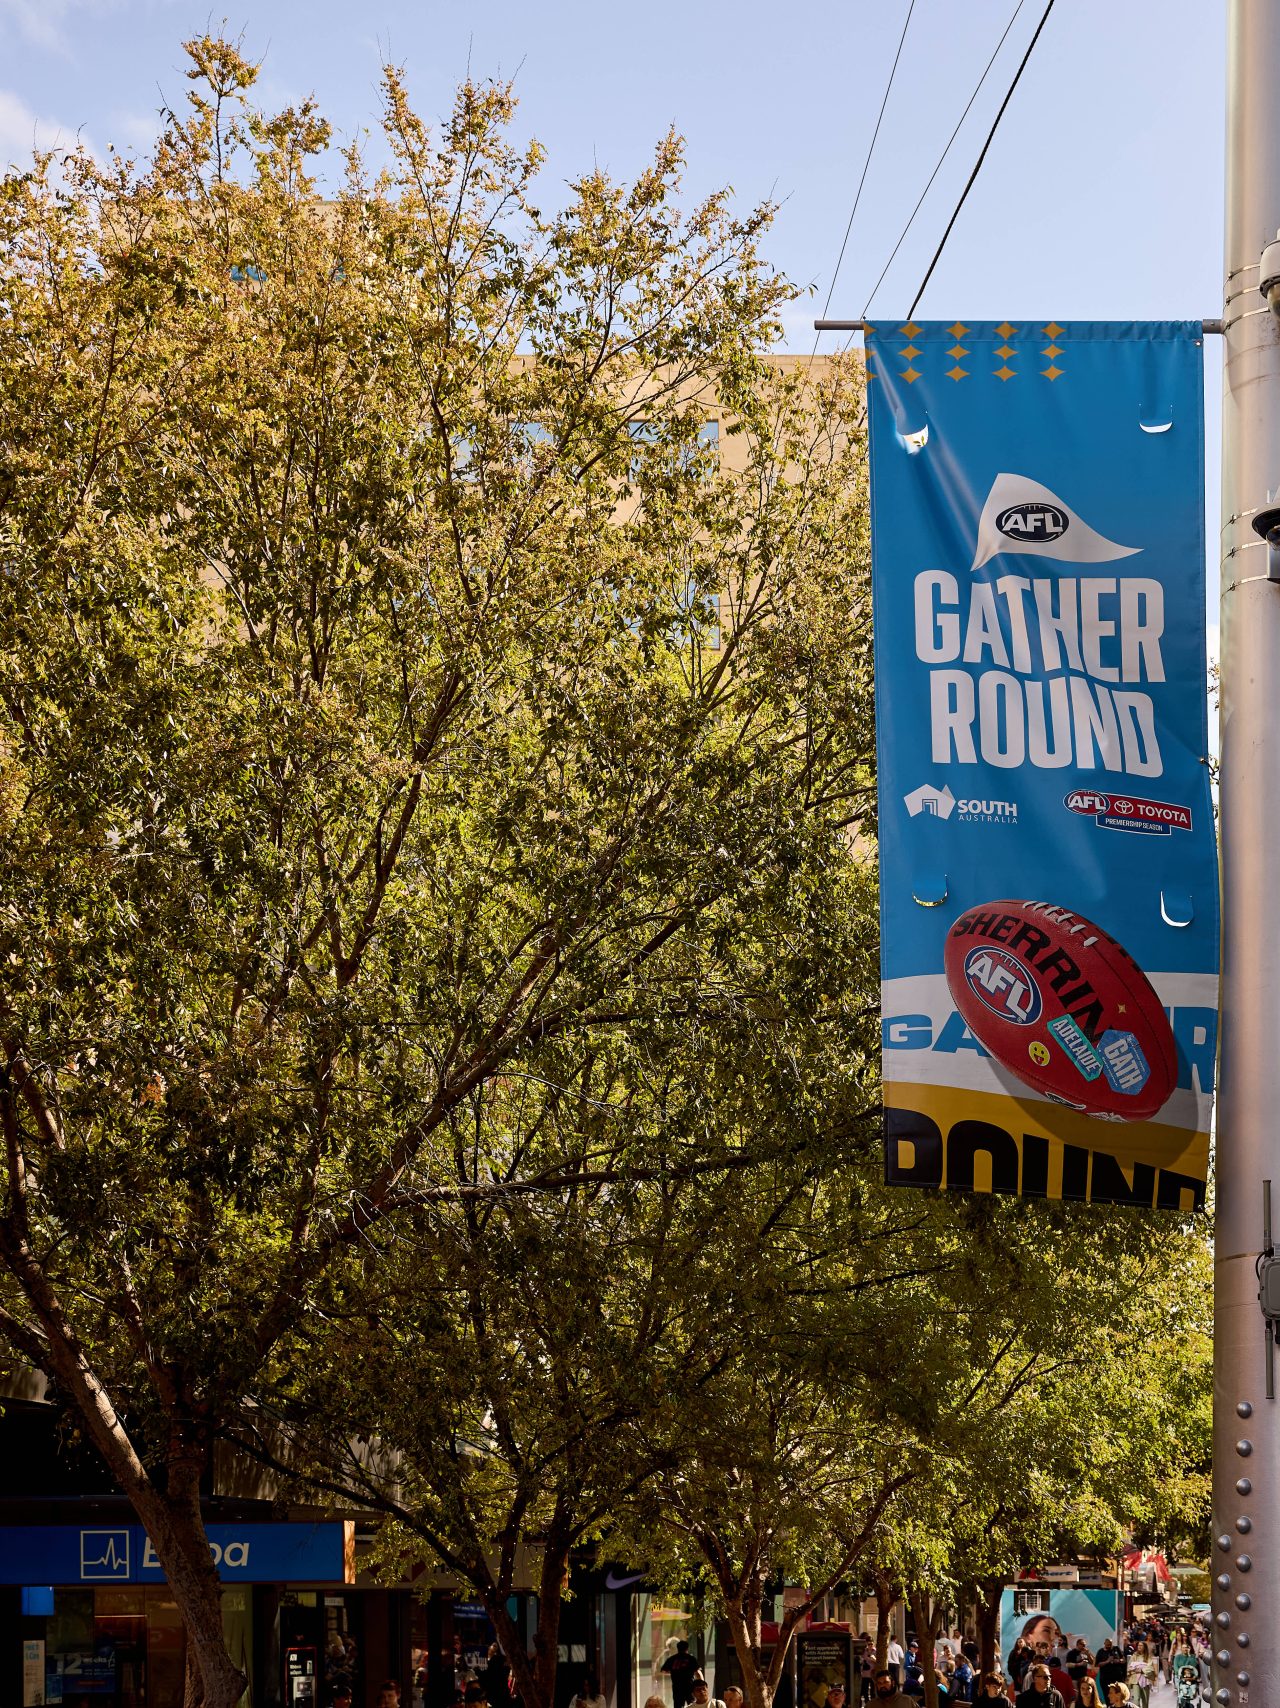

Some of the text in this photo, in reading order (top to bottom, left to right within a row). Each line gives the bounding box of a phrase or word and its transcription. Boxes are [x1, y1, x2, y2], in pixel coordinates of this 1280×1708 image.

[1002, 512, 1064, 533] AFL
[914, 569, 1166, 683] GATHER
[929, 668, 1164, 778] ROUND
[957, 799, 1018, 817] SOUTH
[958, 814, 1018, 825] AUSTRALIA
[1068, 795, 1188, 824] AFL TOYOTA
[1105, 817, 1163, 831] PREMIERSHIP SEASON
[952, 912, 1113, 1045] SHERRIN
[967, 954, 1029, 1022] AFL
[1053, 1019, 1101, 1074] ADELAIDE
[1104, 1038, 1143, 1089] GATH
[142, 1536, 250, 1568] Ba
